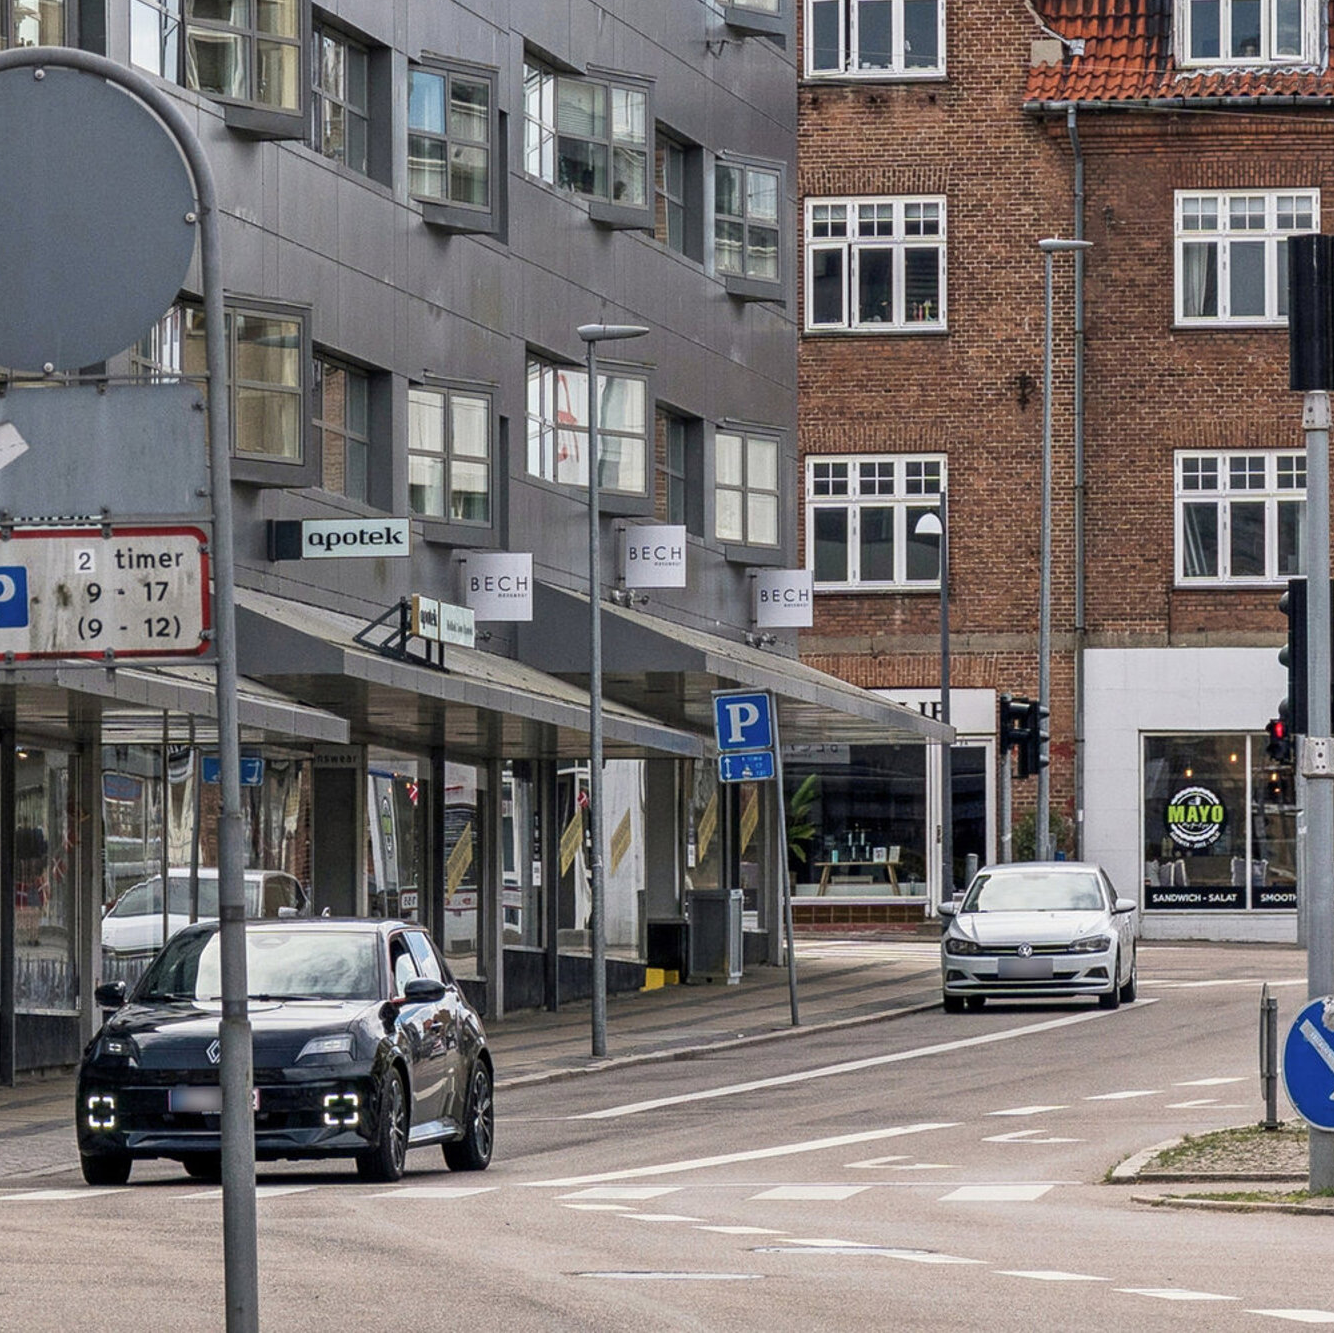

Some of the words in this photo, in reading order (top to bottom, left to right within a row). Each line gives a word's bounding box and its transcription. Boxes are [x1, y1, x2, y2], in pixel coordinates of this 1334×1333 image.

[308, 527, 403, 551] apotek
[78, 552, 91, 570] 2
[115, 547, 184, 569] timer
[629, 546, 682, 561] BECH
[87, 582, 101, 603] 9
[144, 581, 168, 602] 17
[470, 576, 528, 592] BECH
[760, 588, 808, 602] BECH
[78, 616, 103, 640] (9
[144, 615, 181, 639] 12)
[725, 703, 759, 743] P
[1168, 805, 1224, 823] MAYO
[1152, 894, 1201, 902] SANDWICH
[1208, 894, 1237, 902] SALAT
